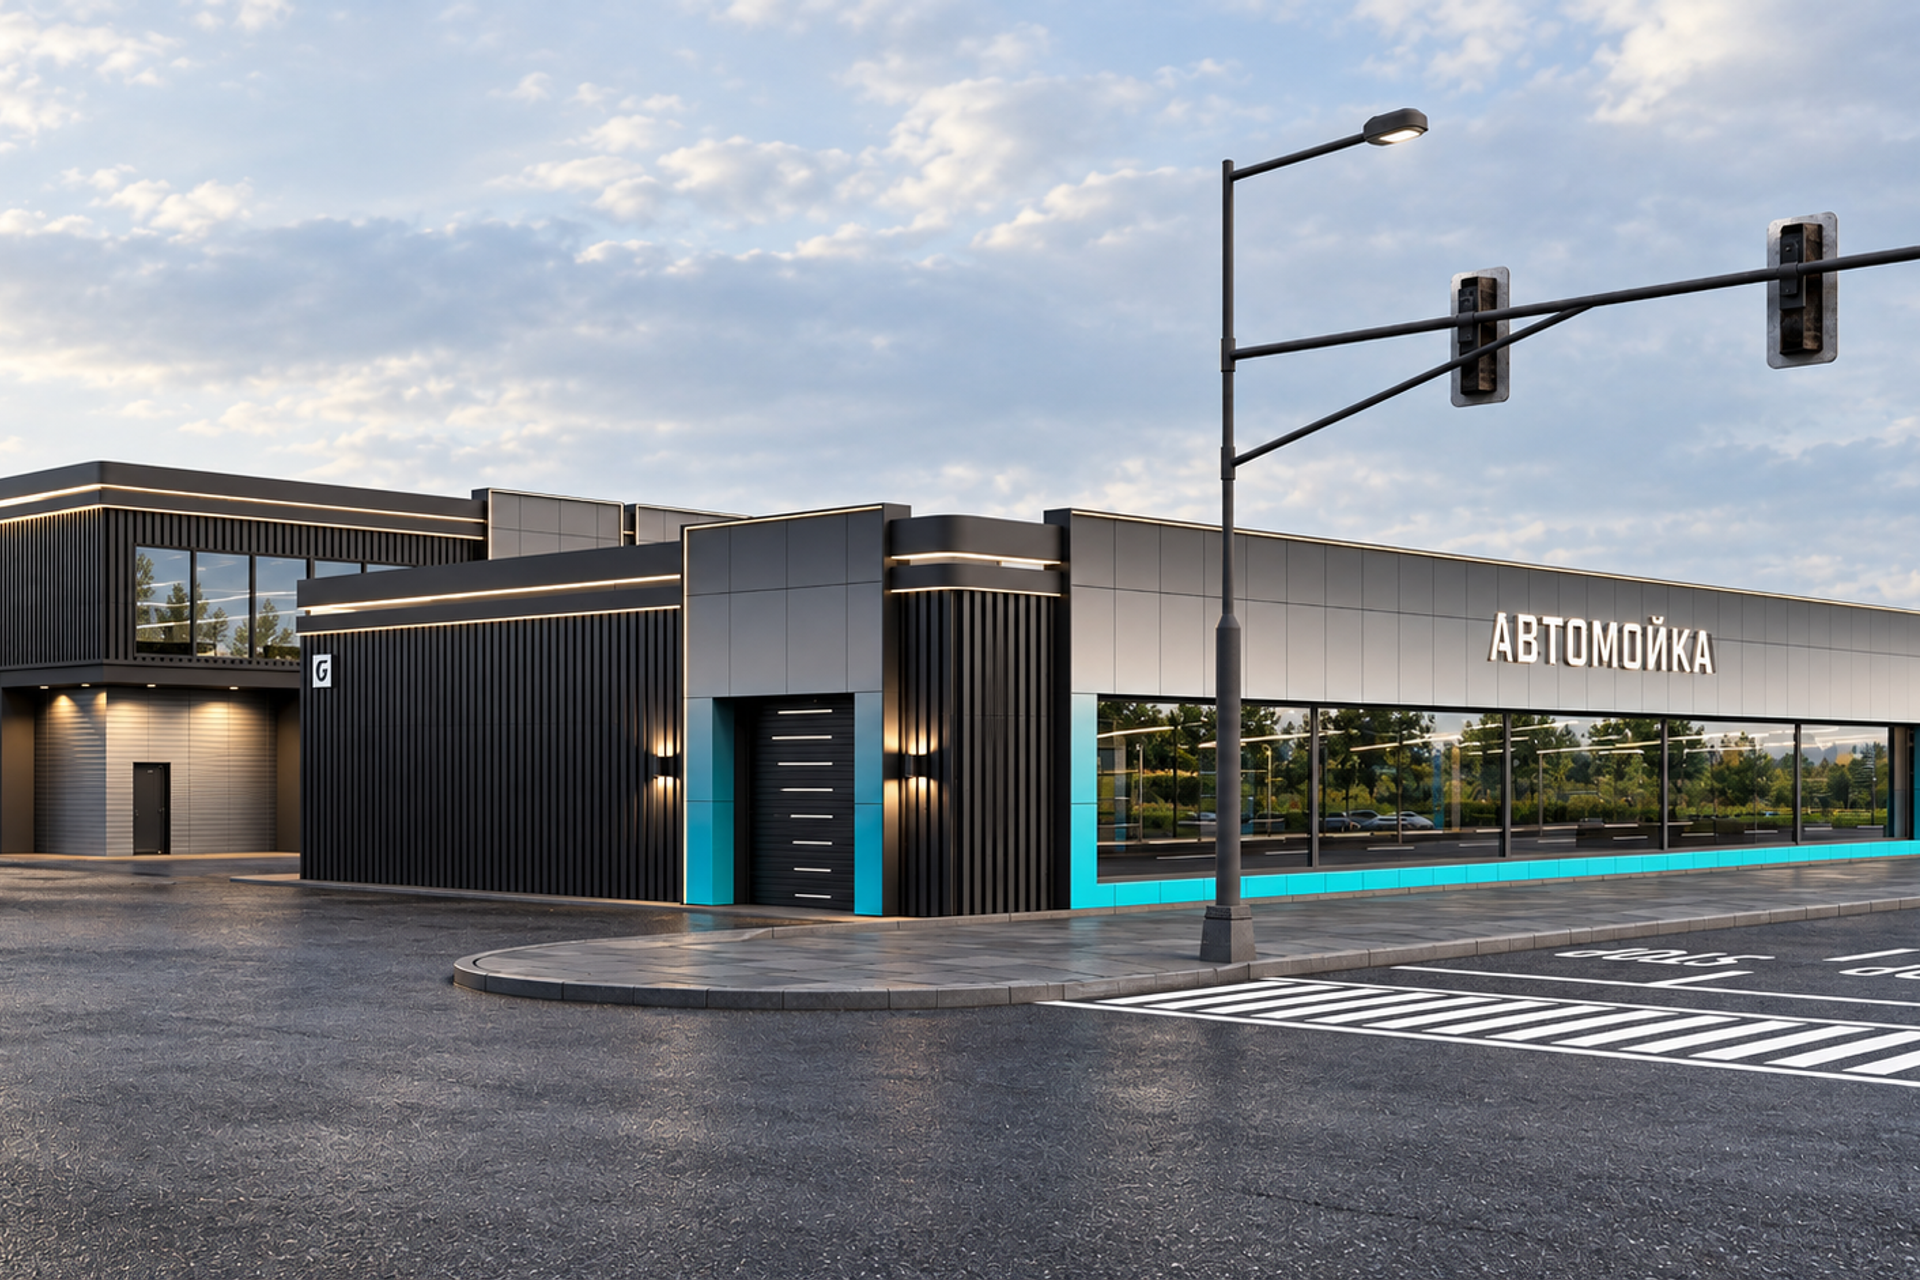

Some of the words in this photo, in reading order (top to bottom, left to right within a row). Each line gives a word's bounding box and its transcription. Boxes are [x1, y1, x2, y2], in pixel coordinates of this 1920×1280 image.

[1488, 612, 1715, 674] АВТОМОЙКА
[316, 660, 328, 682] G
[1554, 948, 1775, 967] STOP
